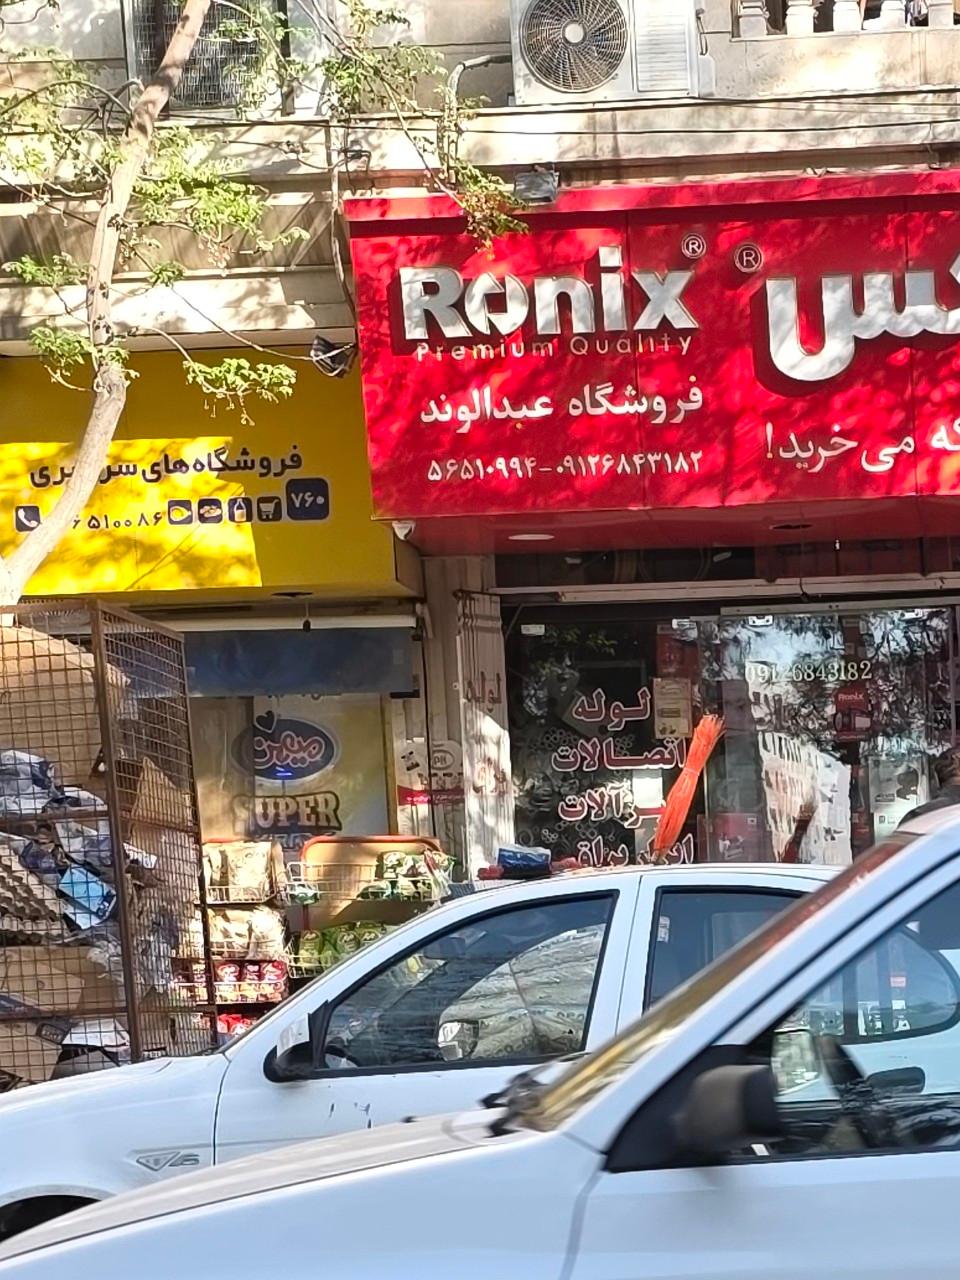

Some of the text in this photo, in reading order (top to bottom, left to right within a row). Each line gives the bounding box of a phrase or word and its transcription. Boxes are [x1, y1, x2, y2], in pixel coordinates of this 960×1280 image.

[400, 245, 699, 341] Ronix
[416, 335, 692, 363] Premium Quality
[420, 375, 703, 433] فروشگاه عبدالوند
[30, 464, 138, 488] سرری
[290, 491, 325, 509] ۷۶۰
[572, 686, 651, 731] لوله
[551, 737, 687, 772] اتصالات
[558, 780, 668, 829] رآلات
